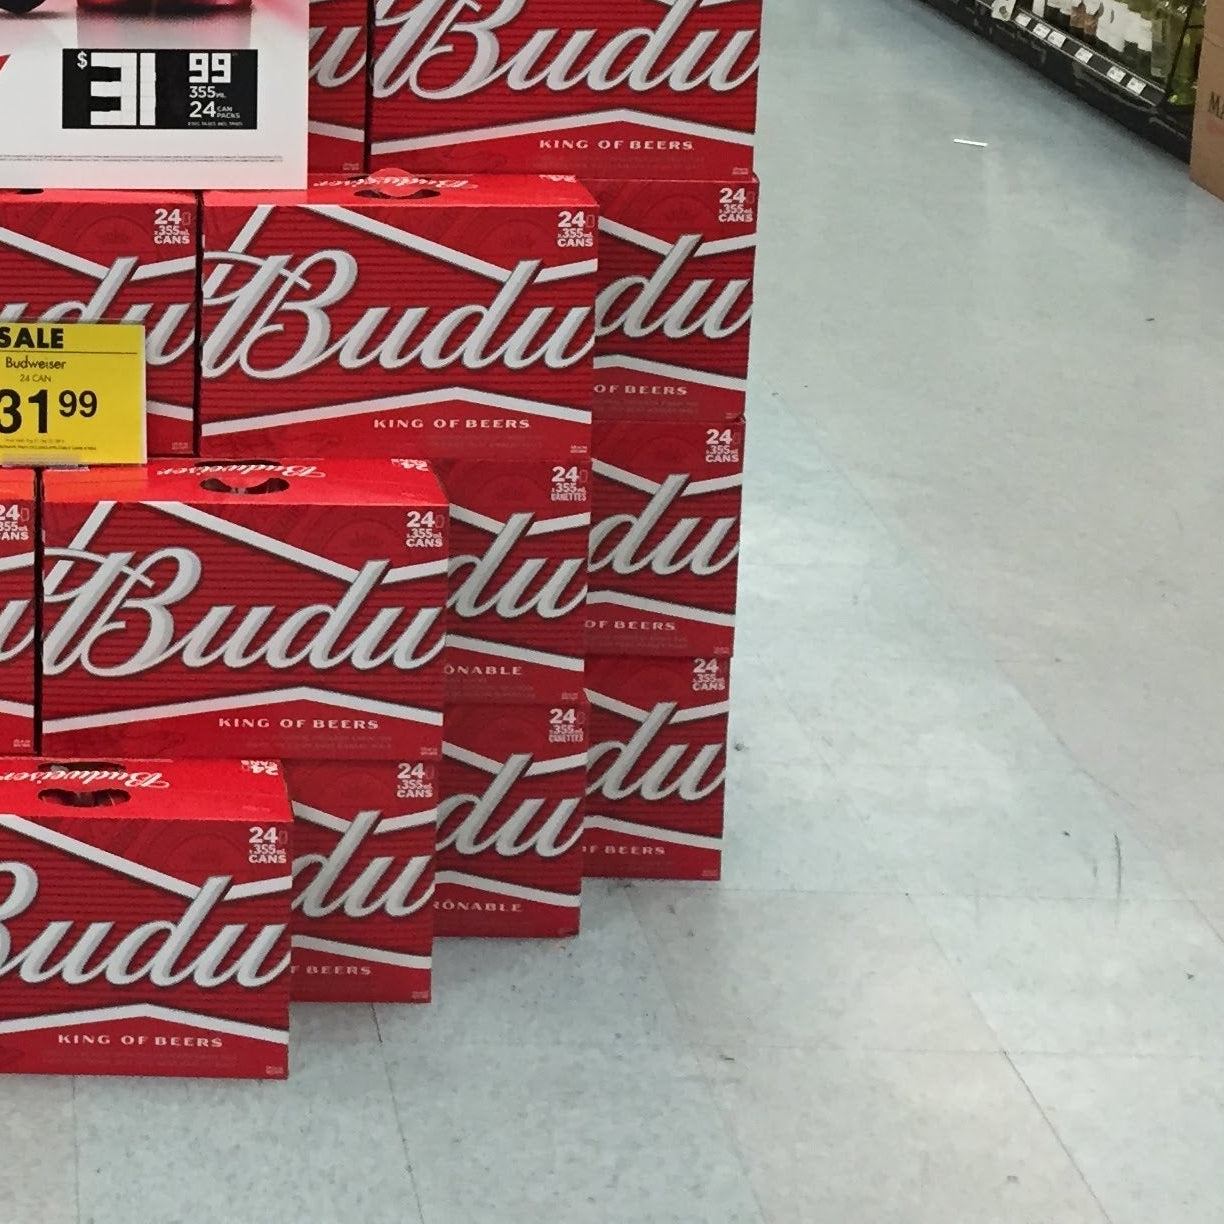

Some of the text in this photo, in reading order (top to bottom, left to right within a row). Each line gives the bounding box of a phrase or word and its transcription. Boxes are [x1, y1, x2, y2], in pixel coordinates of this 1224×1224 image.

[189, 52, 231, 83] 99
[189, 101, 216, 118] 24
[539, 140, 692, 150] KING OF BEERS
[718, 187, 747, 204] 24
[154, 208, 181, 225] 24
[558, 211, 585, 228] 24
[718, 213, 753, 223] CANS
[154, 236, 189, 245] CANS
[557, 238, 593, 247] CANS
[5, 355, 66, 369] Budweiser
[32, 374, 52, 383] CAN
[624, 384, 687, 395] BEERS
[373, 419, 531, 429] KING OF BEERS
[706, 429, 732, 445] 24
[706, 454, 739, 463] CANS
[552, 467, 579, 483] 24
[407, 511, 435, 528] 24
[406, 538, 443, 547] CANS
[614, 621, 676, 630] BEERS
[693, 658, 719, 673] 24
[693, 682, 725, 691] CANS
[549, 709, 576, 724] 24
[218, 718, 379, 729] KING OF BEERS
[397, 763, 425, 779] 24
[397, 789, 432, 798] CANS
[249, 827, 277, 843] 24
[603, 846, 666, 855] BEERS
[248, 854, 286, 864] CANS
[305, 966, 372, 975] BEERS
[58, 1034, 223, 1046] KING OF BEERS
